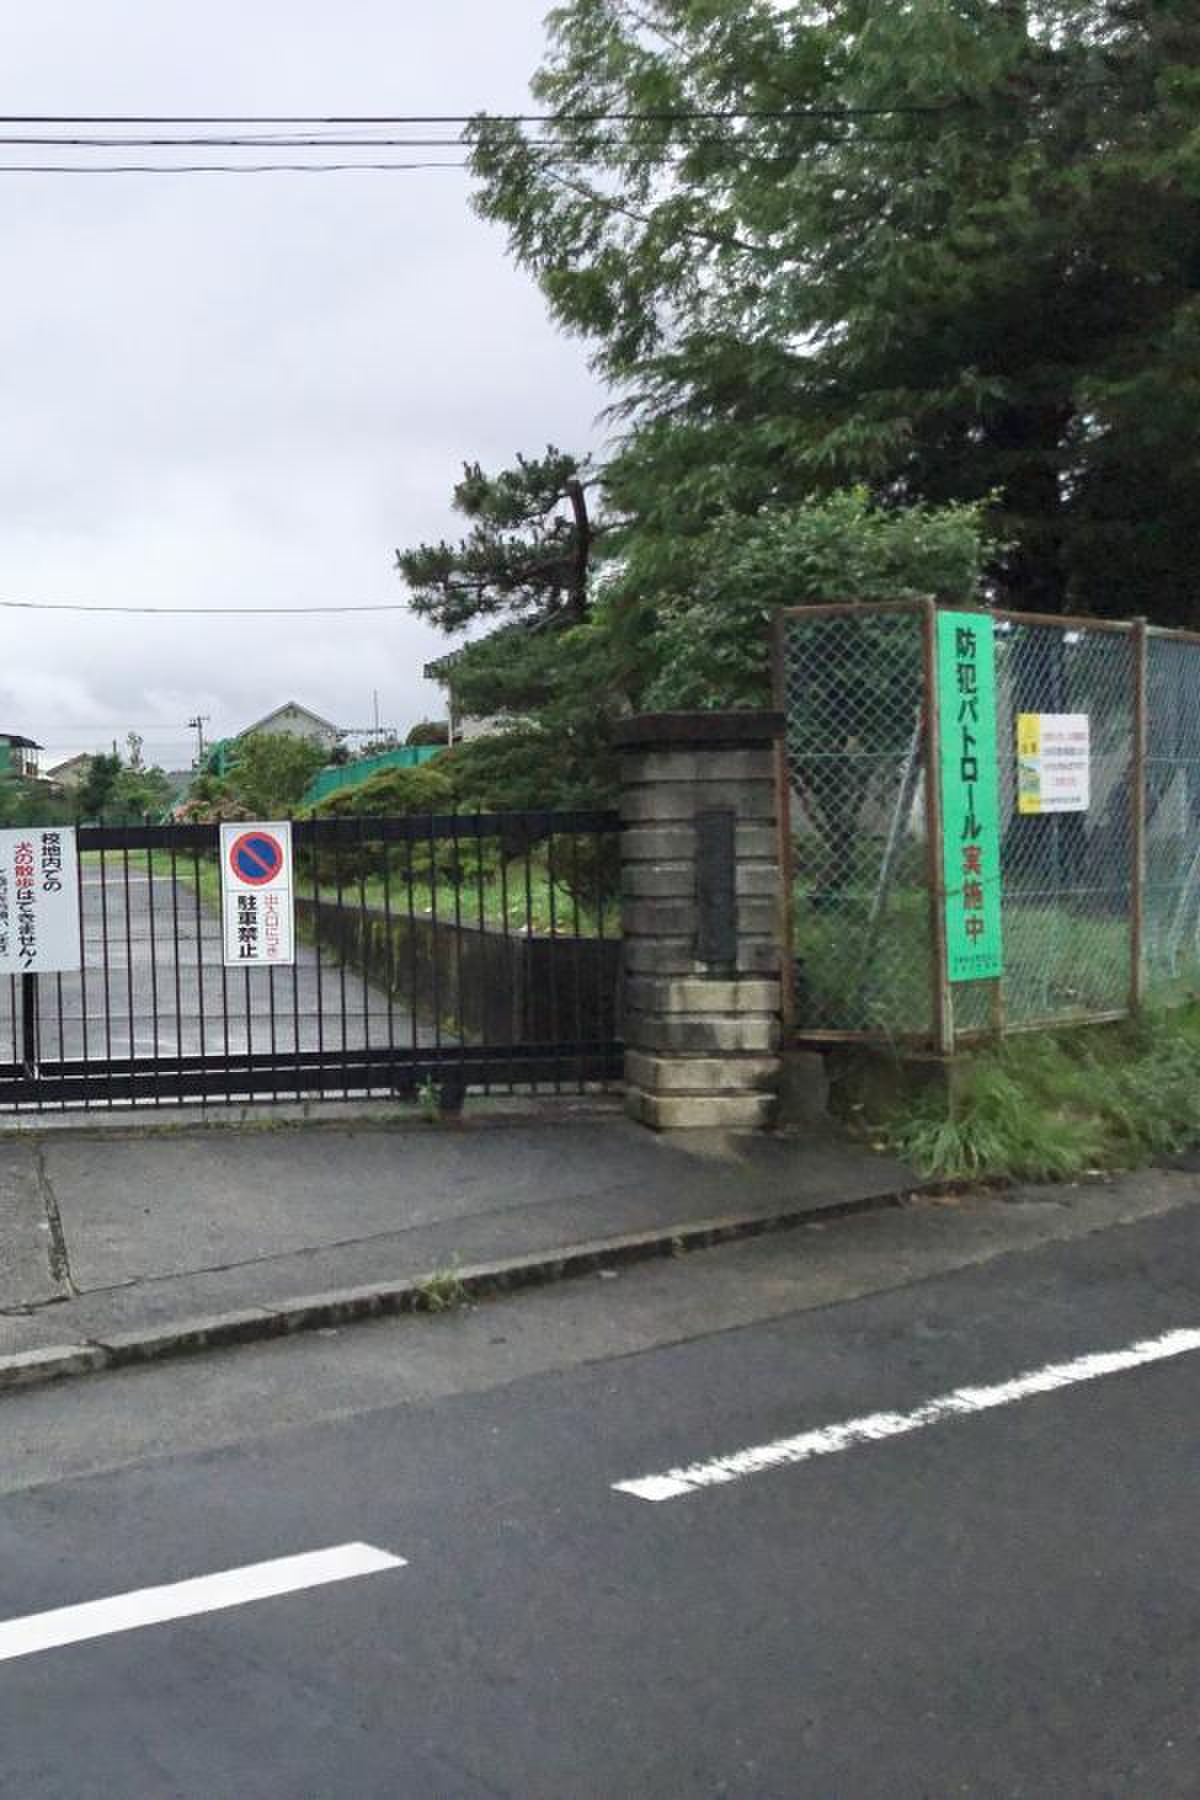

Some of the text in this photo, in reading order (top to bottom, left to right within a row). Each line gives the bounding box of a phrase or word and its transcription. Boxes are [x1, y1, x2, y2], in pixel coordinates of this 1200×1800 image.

[954, 627, 986, 944] 防犯パトロール実施中
[40, 832, 63, 892] 校地内での
[237, 895, 258, 959] 駐車禁止
